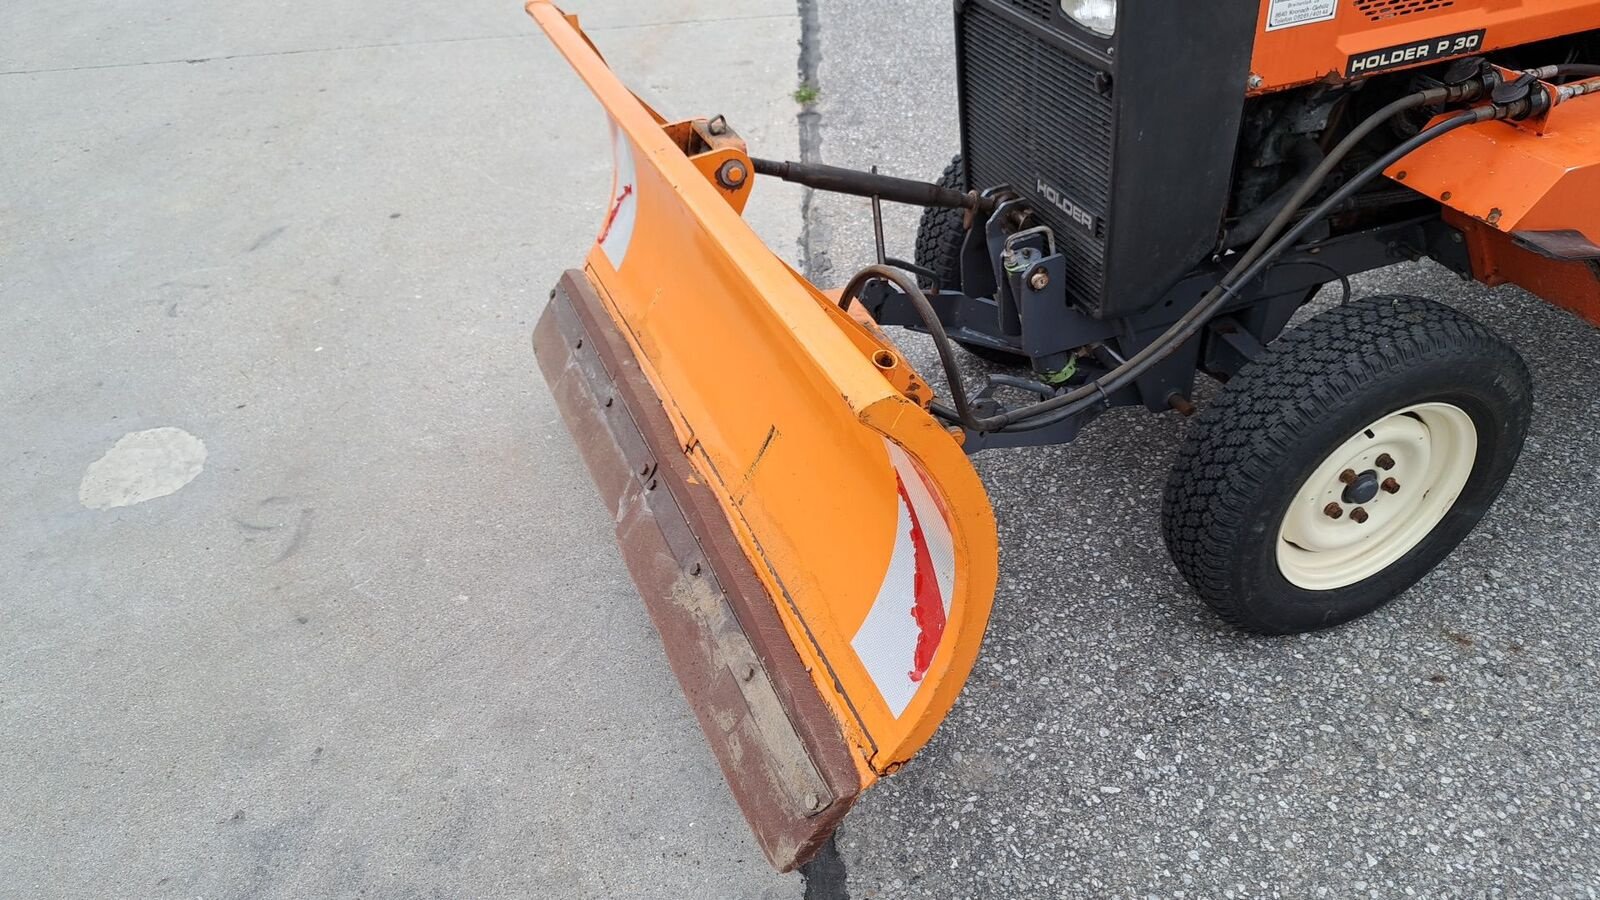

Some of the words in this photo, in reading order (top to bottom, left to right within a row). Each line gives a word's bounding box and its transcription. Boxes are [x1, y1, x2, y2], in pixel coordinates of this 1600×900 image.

[1351, 45, 1430, 72] HOLDER
[1436, 40, 1450, 54] P
[1454, 35, 1479, 50] 30
[1037, 179, 1092, 230] HOLDER
